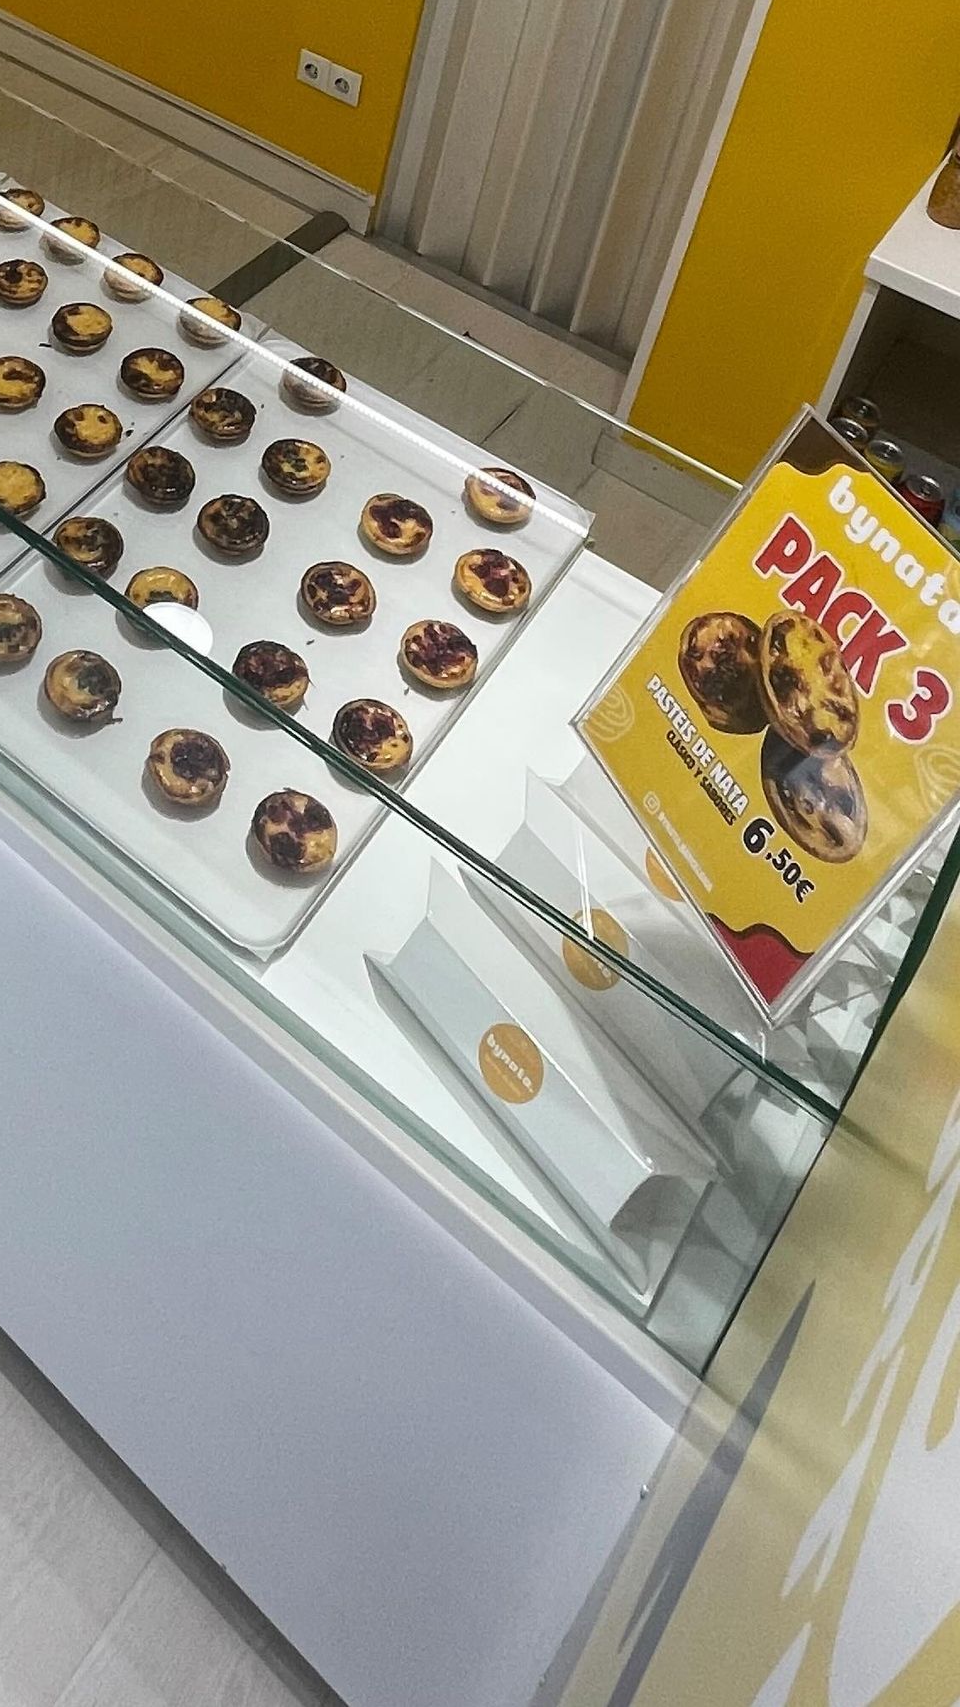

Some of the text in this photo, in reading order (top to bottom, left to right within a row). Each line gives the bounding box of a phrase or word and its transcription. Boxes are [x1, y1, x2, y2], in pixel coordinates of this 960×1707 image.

[752, 513, 952, 743] PACK 3
[691, 735, 716, 768] DE
[710, 760, 749, 816] NATA
[694, 767, 703, 778] Y
[700, 776, 737, 826] SABORES
[486, 1033, 534, 1093] bynata.
